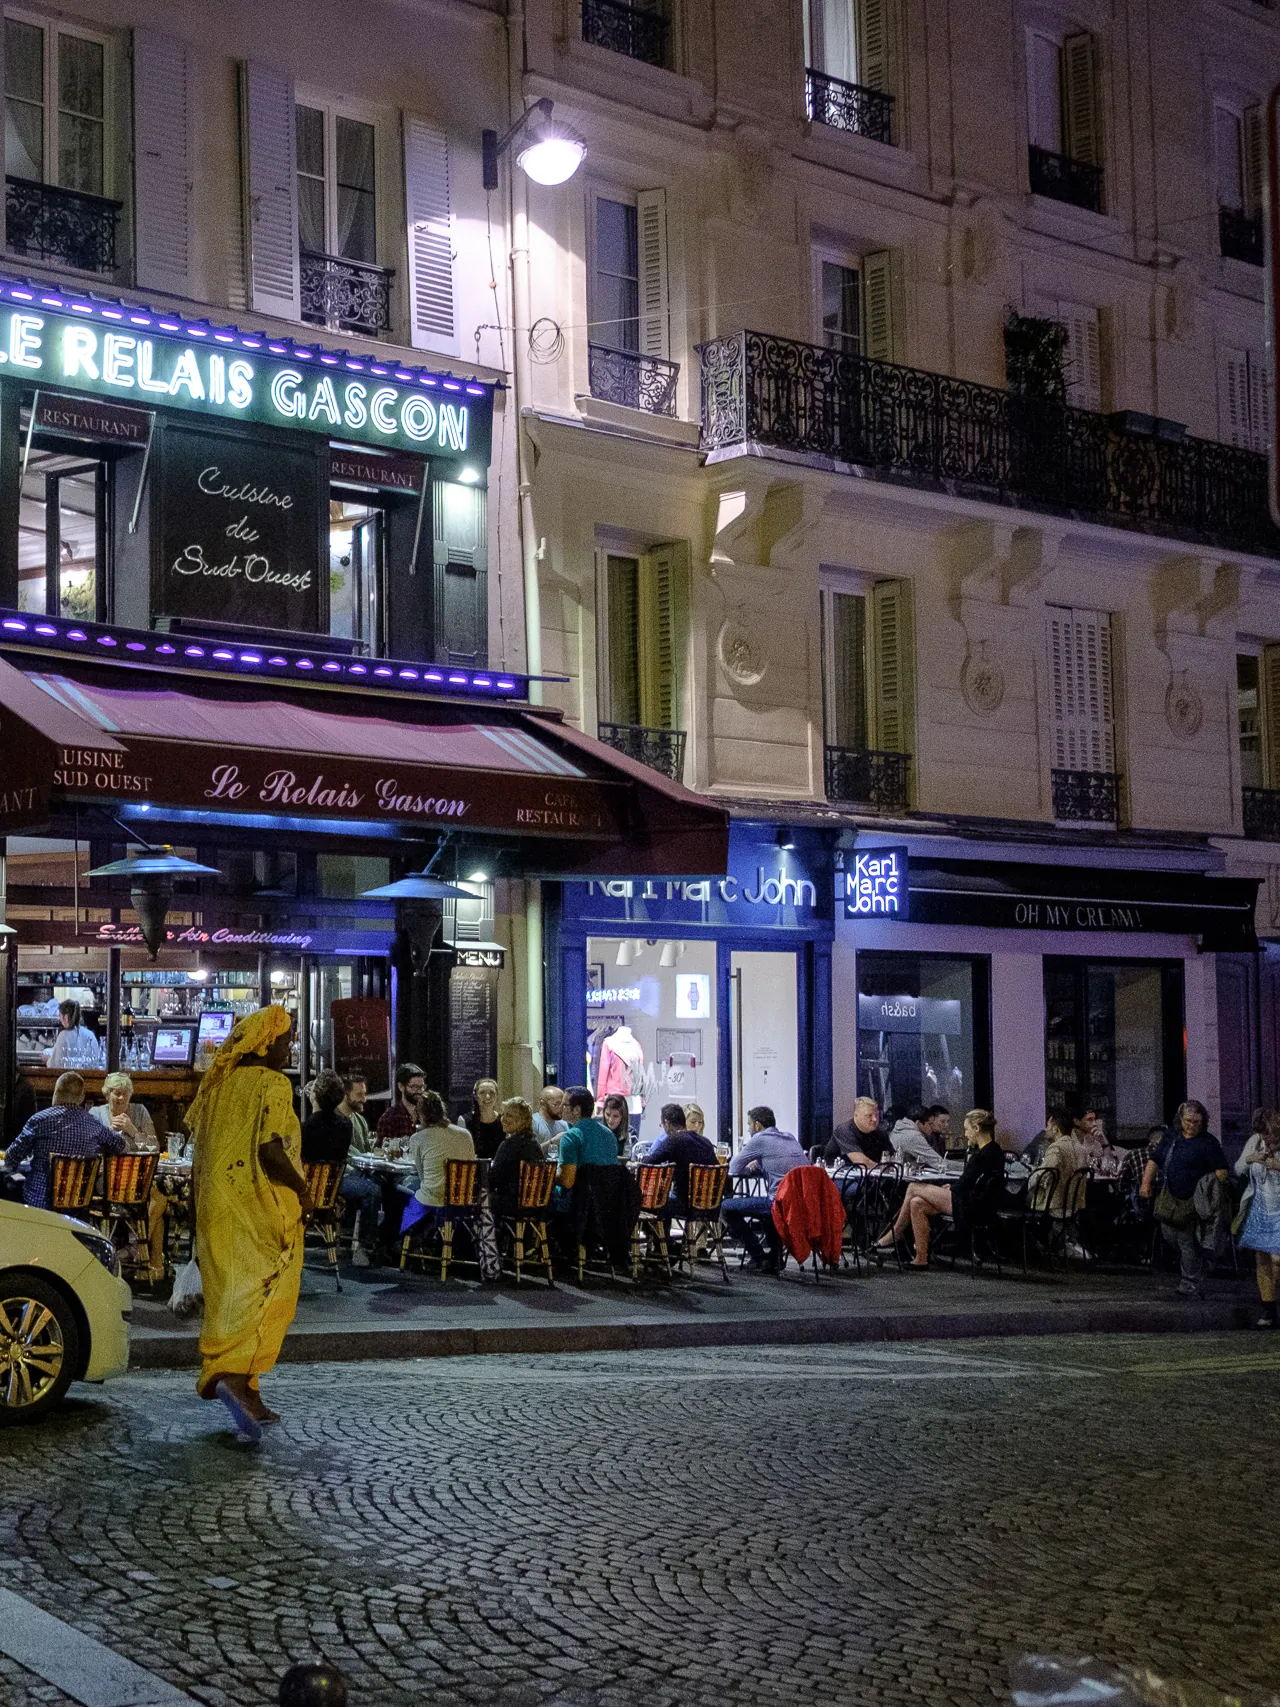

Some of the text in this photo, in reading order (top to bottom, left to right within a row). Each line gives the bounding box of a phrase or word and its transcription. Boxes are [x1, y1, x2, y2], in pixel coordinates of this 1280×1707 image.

[63, 324, 254, 407] RELAIS
[271, 369, 468, 451] GASCON
[41, 407, 141, 439] RESTAURANT
[331, 461, 417, 488] RESTAURANT
[197, 465, 295, 511] Cuisine
[225, 516, 260, 543] du
[60, 749, 124, 769] UISINE
[53, 769, 153, 792] SUD OUEST
[204, 765, 471, 818] Le Relais Gascon
[855, 853, 899, 877] Karl
[743, 867, 817, 908] John
[847, 873, 898, 895] Marc
[848, 889, 898, 913] John
[1015, 902, 1039, 925] OH
[1046, 903, 1070, 926] MY
[177, 927, 210, 943] Air
[211, 927, 313, 949] Conditioning
[456, 951, 500, 966] MENU
